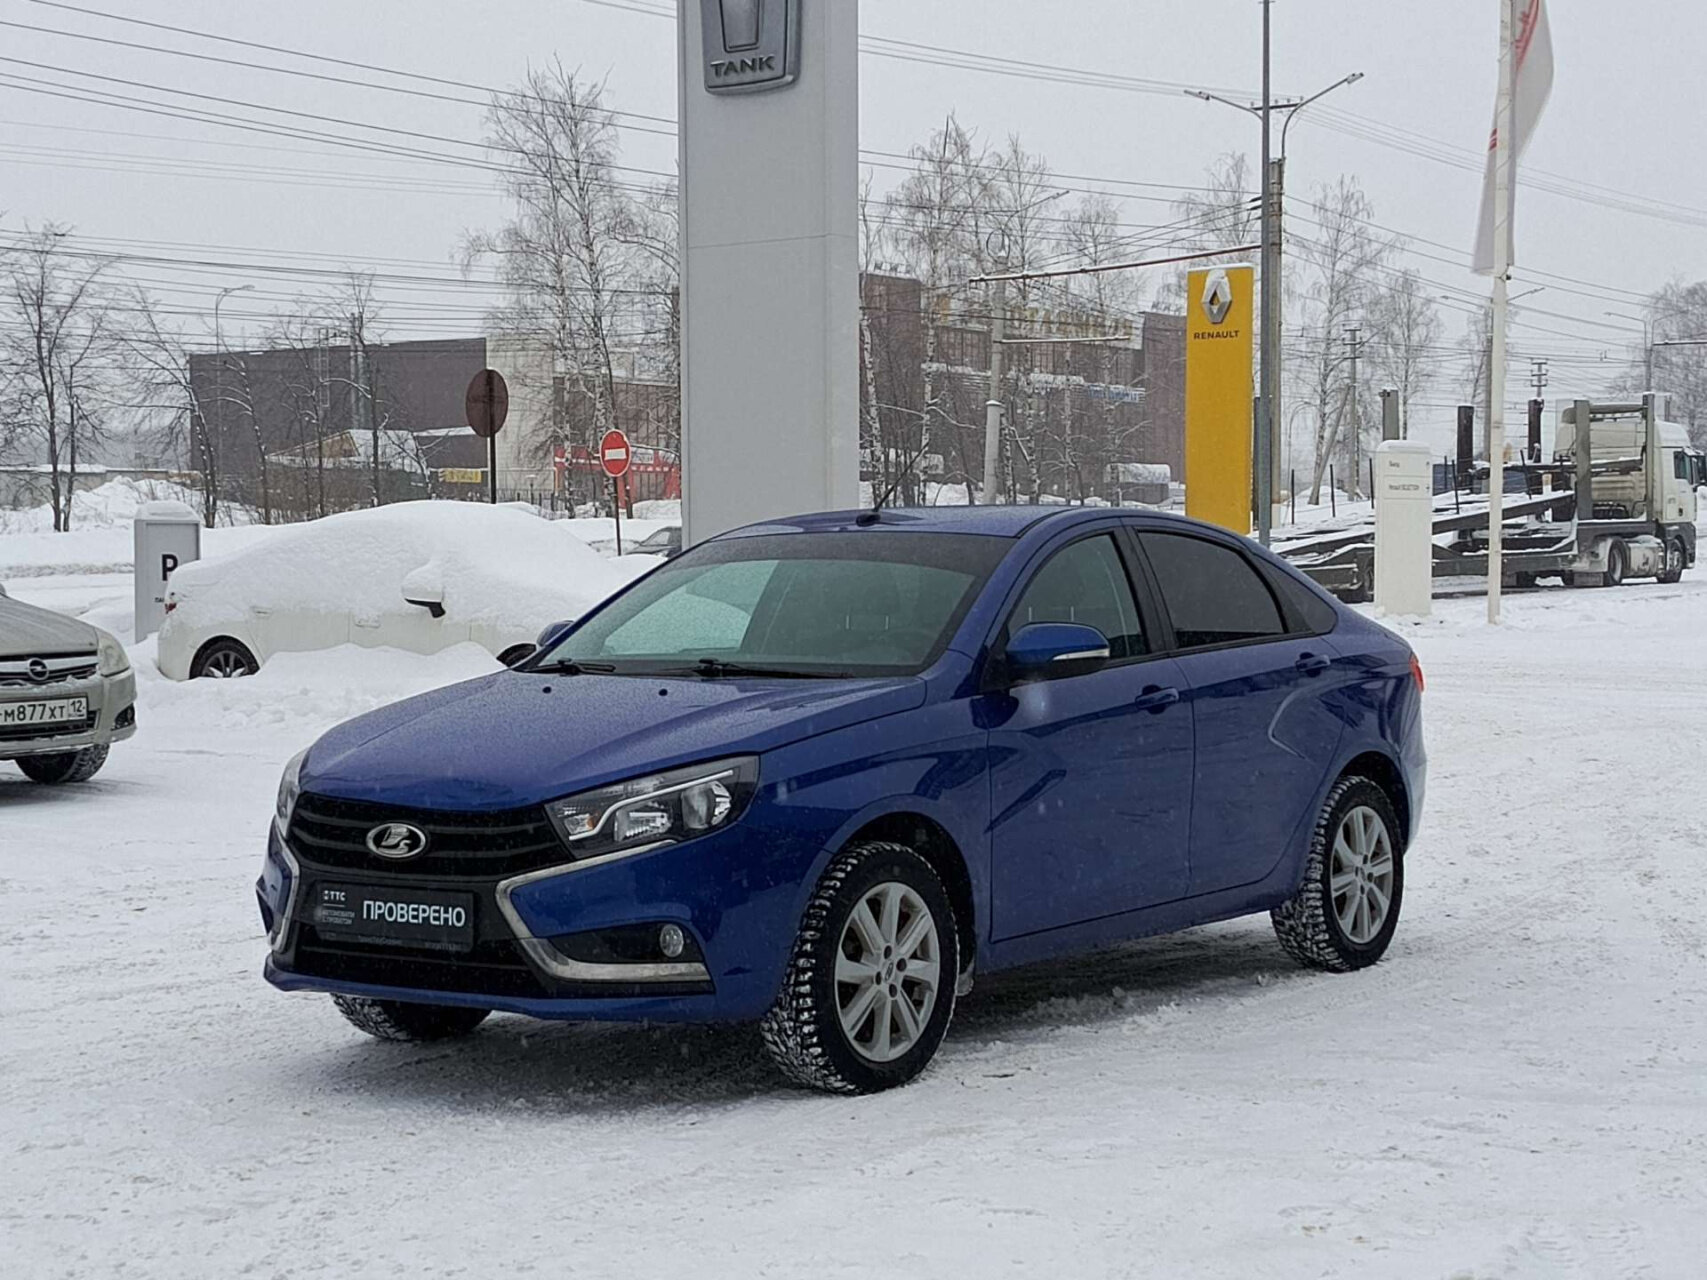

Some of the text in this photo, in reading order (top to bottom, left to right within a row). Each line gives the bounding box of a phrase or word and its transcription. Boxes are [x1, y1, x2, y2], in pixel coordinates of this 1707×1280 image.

[710, 54, 775, 77] TANK
[1193, 330, 1240, 340] RENAULT
[162, 554, 178, 581] P
[70, 700, 83, 713] 12
[363, 900, 466, 927] ПРОВЕРЕНО
